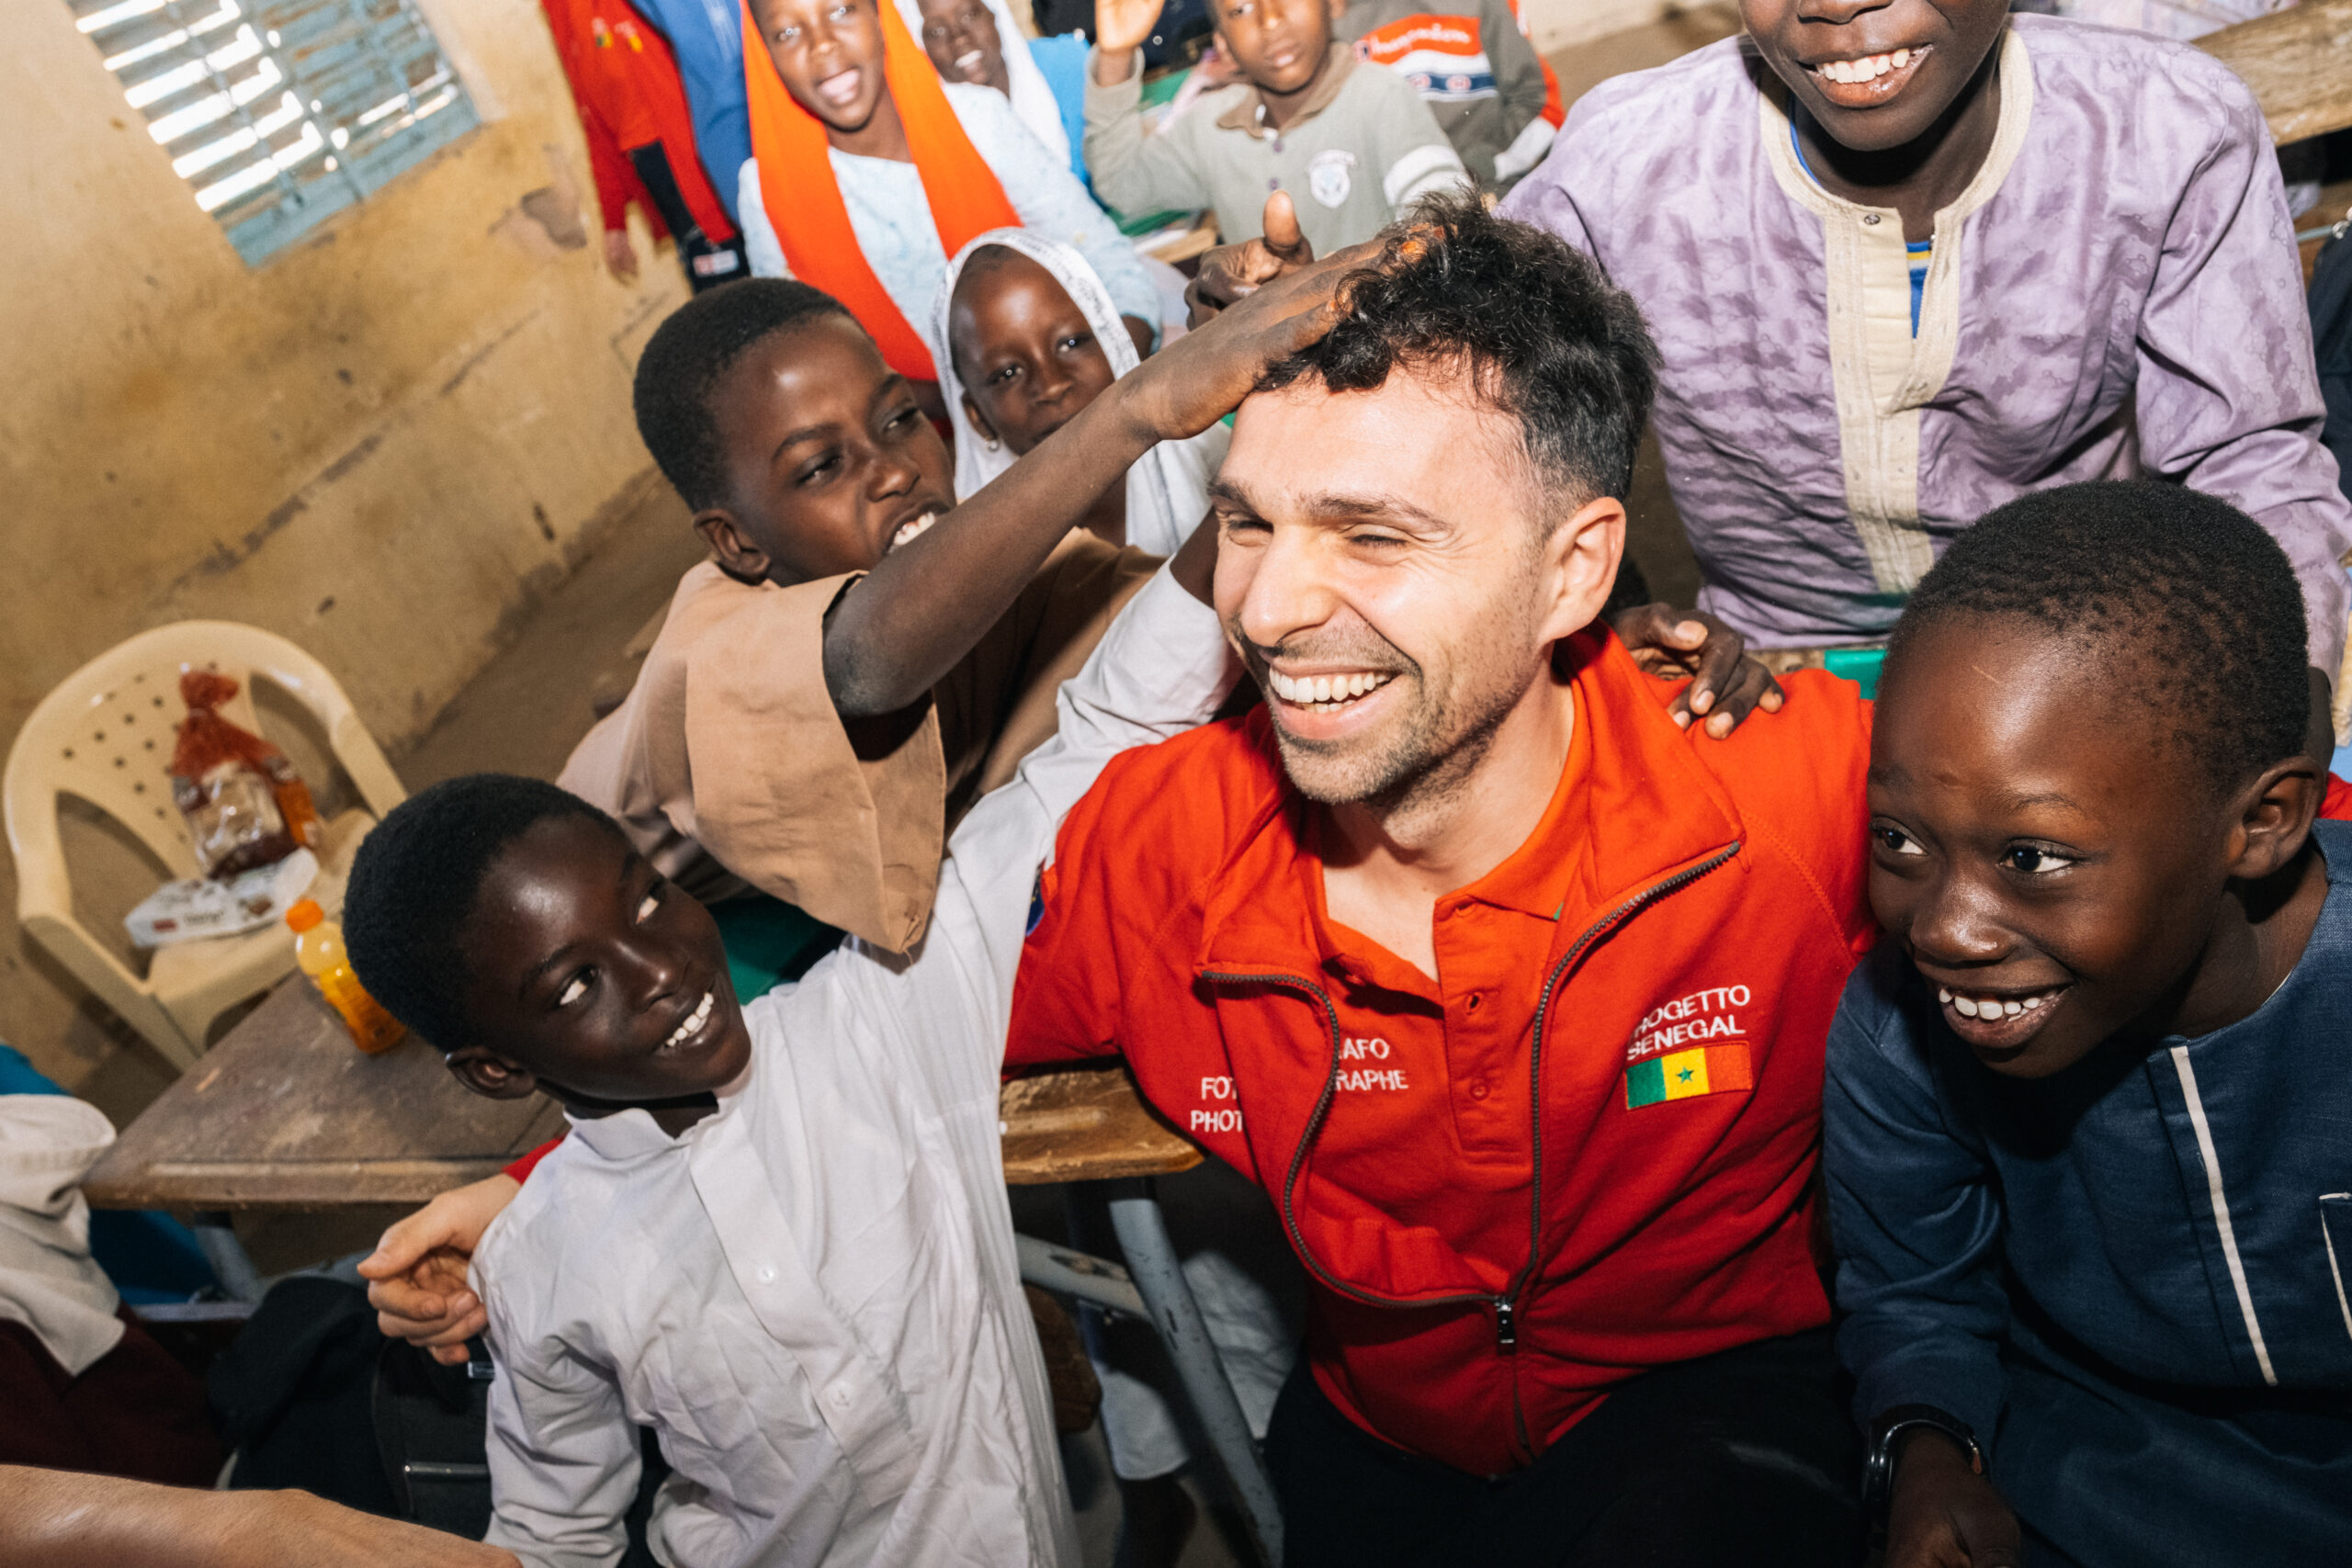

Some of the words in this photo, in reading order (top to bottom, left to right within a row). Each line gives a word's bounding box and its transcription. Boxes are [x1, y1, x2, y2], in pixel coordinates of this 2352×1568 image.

[1633, 985, 1750, 1039] ROGETTO
[1338, 1037, 1390, 1060] AFO
[1627, 1014, 1746, 1060] SENEGAL
